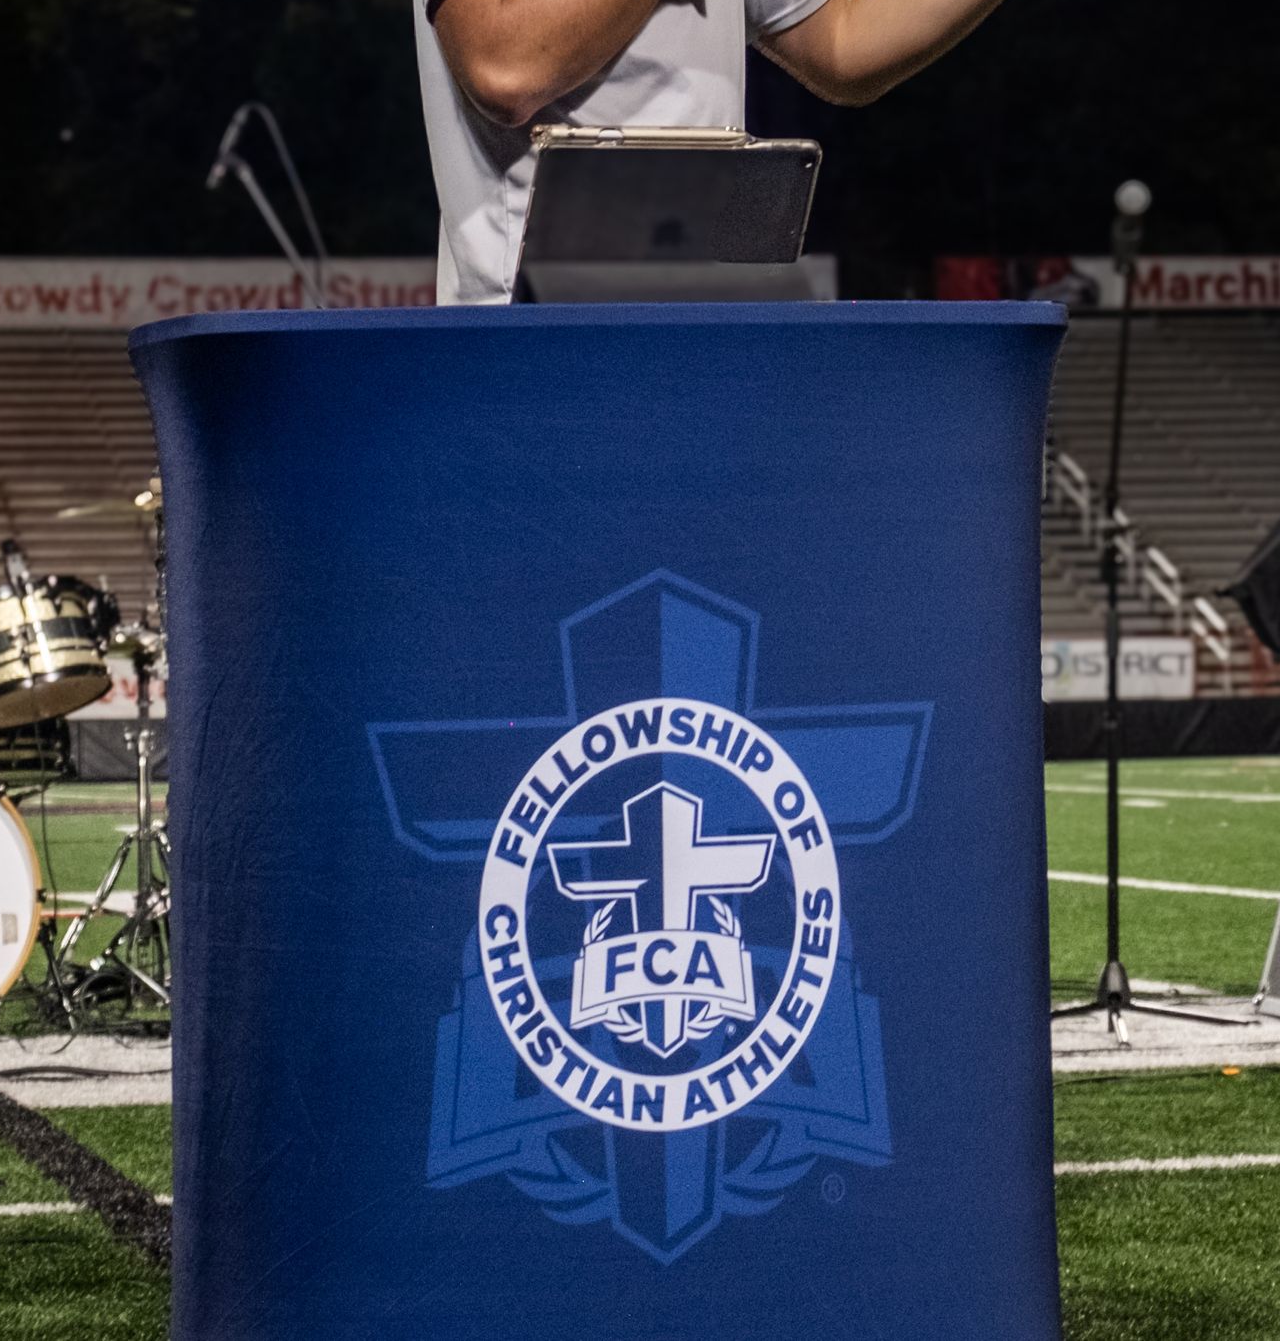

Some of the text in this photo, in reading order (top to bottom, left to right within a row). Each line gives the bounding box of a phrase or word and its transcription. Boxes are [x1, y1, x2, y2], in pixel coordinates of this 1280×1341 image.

[147, 272, 305, 314] Crowd
[494, 706, 824, 868] FELLOWSHIP OF
[485, 887, 834, 1124] CHRISTIAN ATHLETES
[604, 938, 726, 994] FCA
